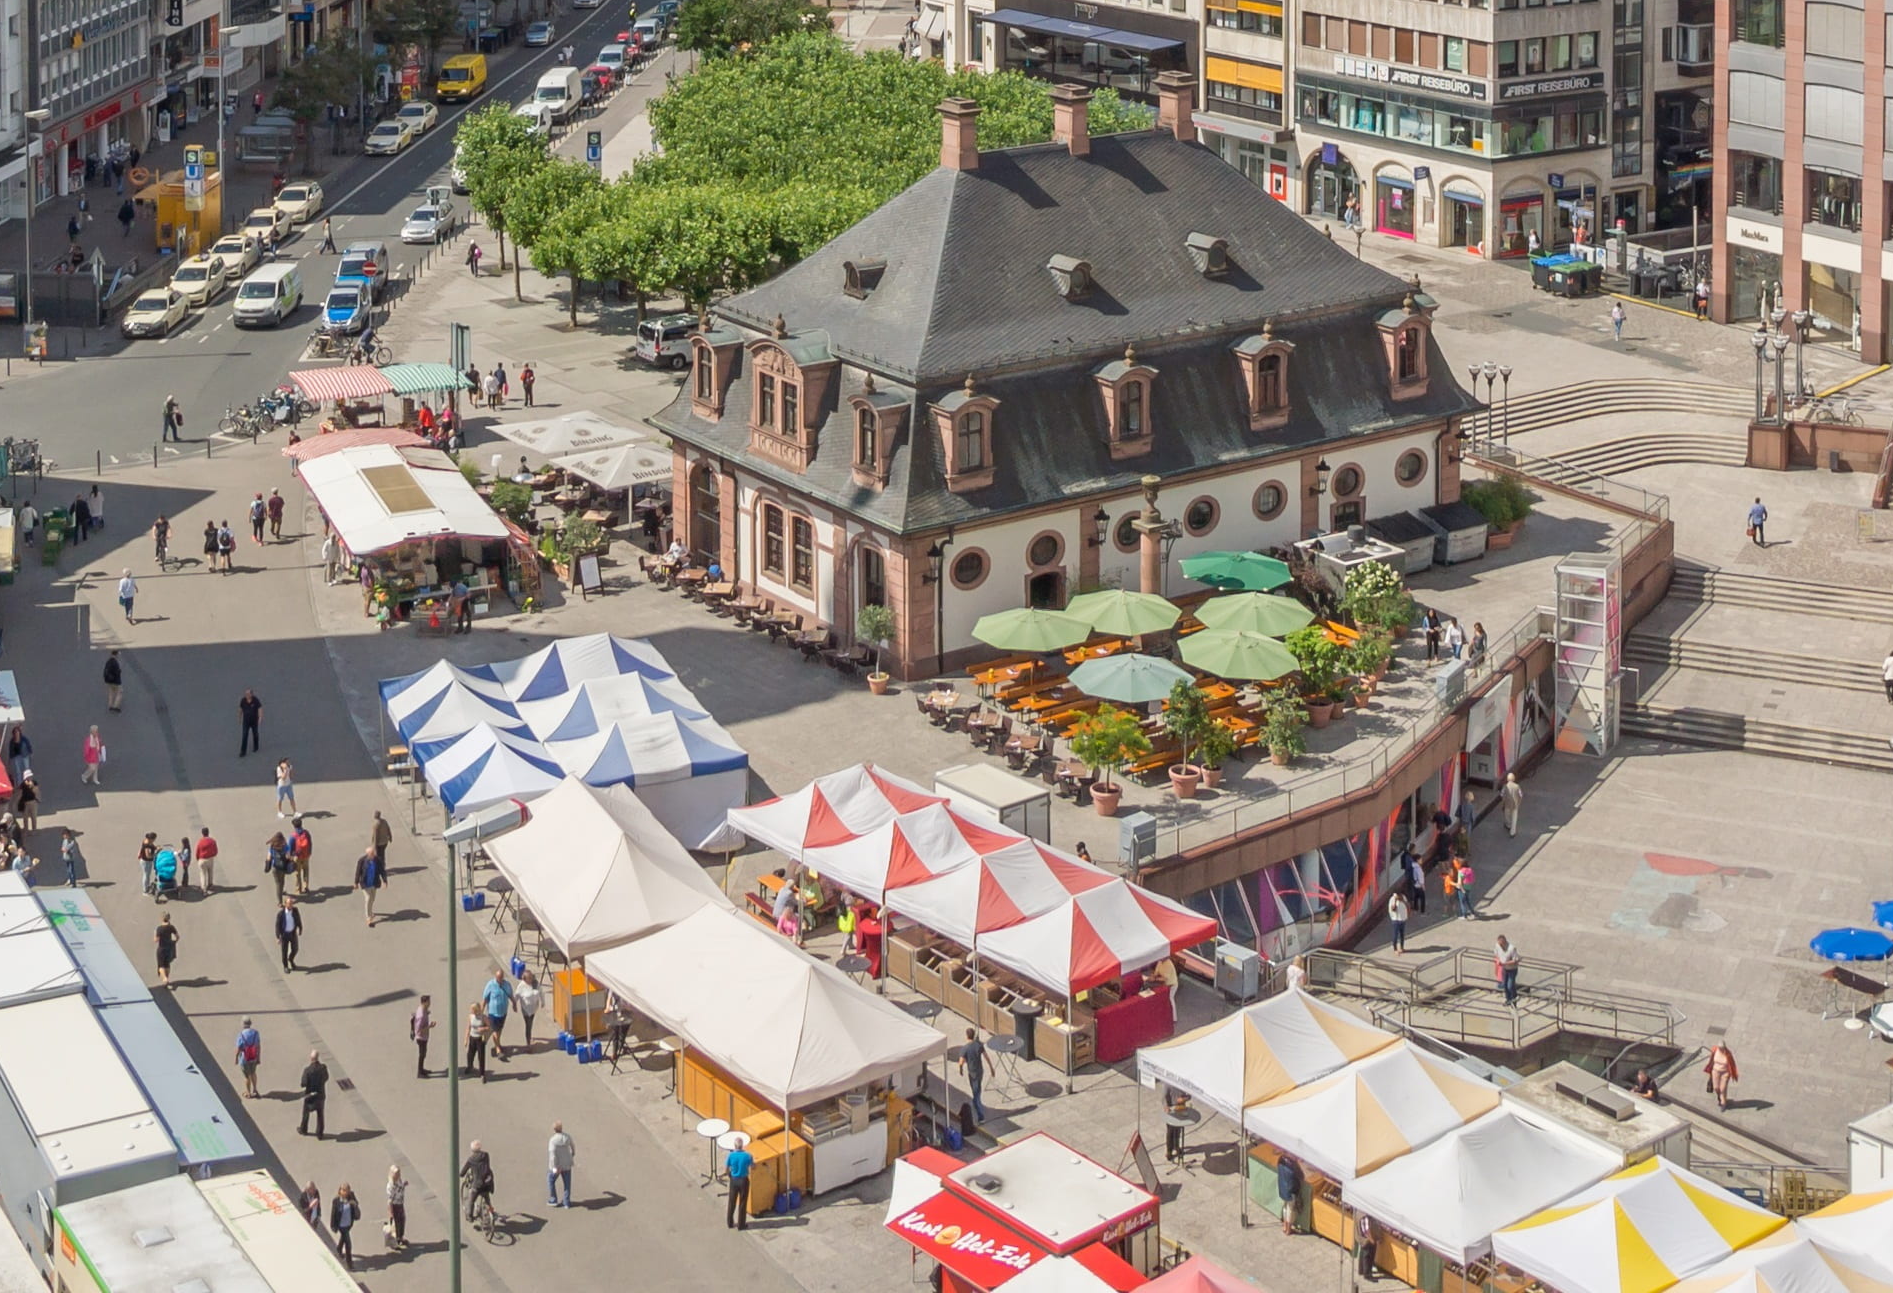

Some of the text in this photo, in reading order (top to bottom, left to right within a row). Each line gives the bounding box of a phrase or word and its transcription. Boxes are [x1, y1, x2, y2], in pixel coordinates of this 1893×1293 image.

[1390, 69, 1471, 95] FIRST REISEBÜRO
[1504, 77, 1589, 98] FIRST REISEBÜRO
